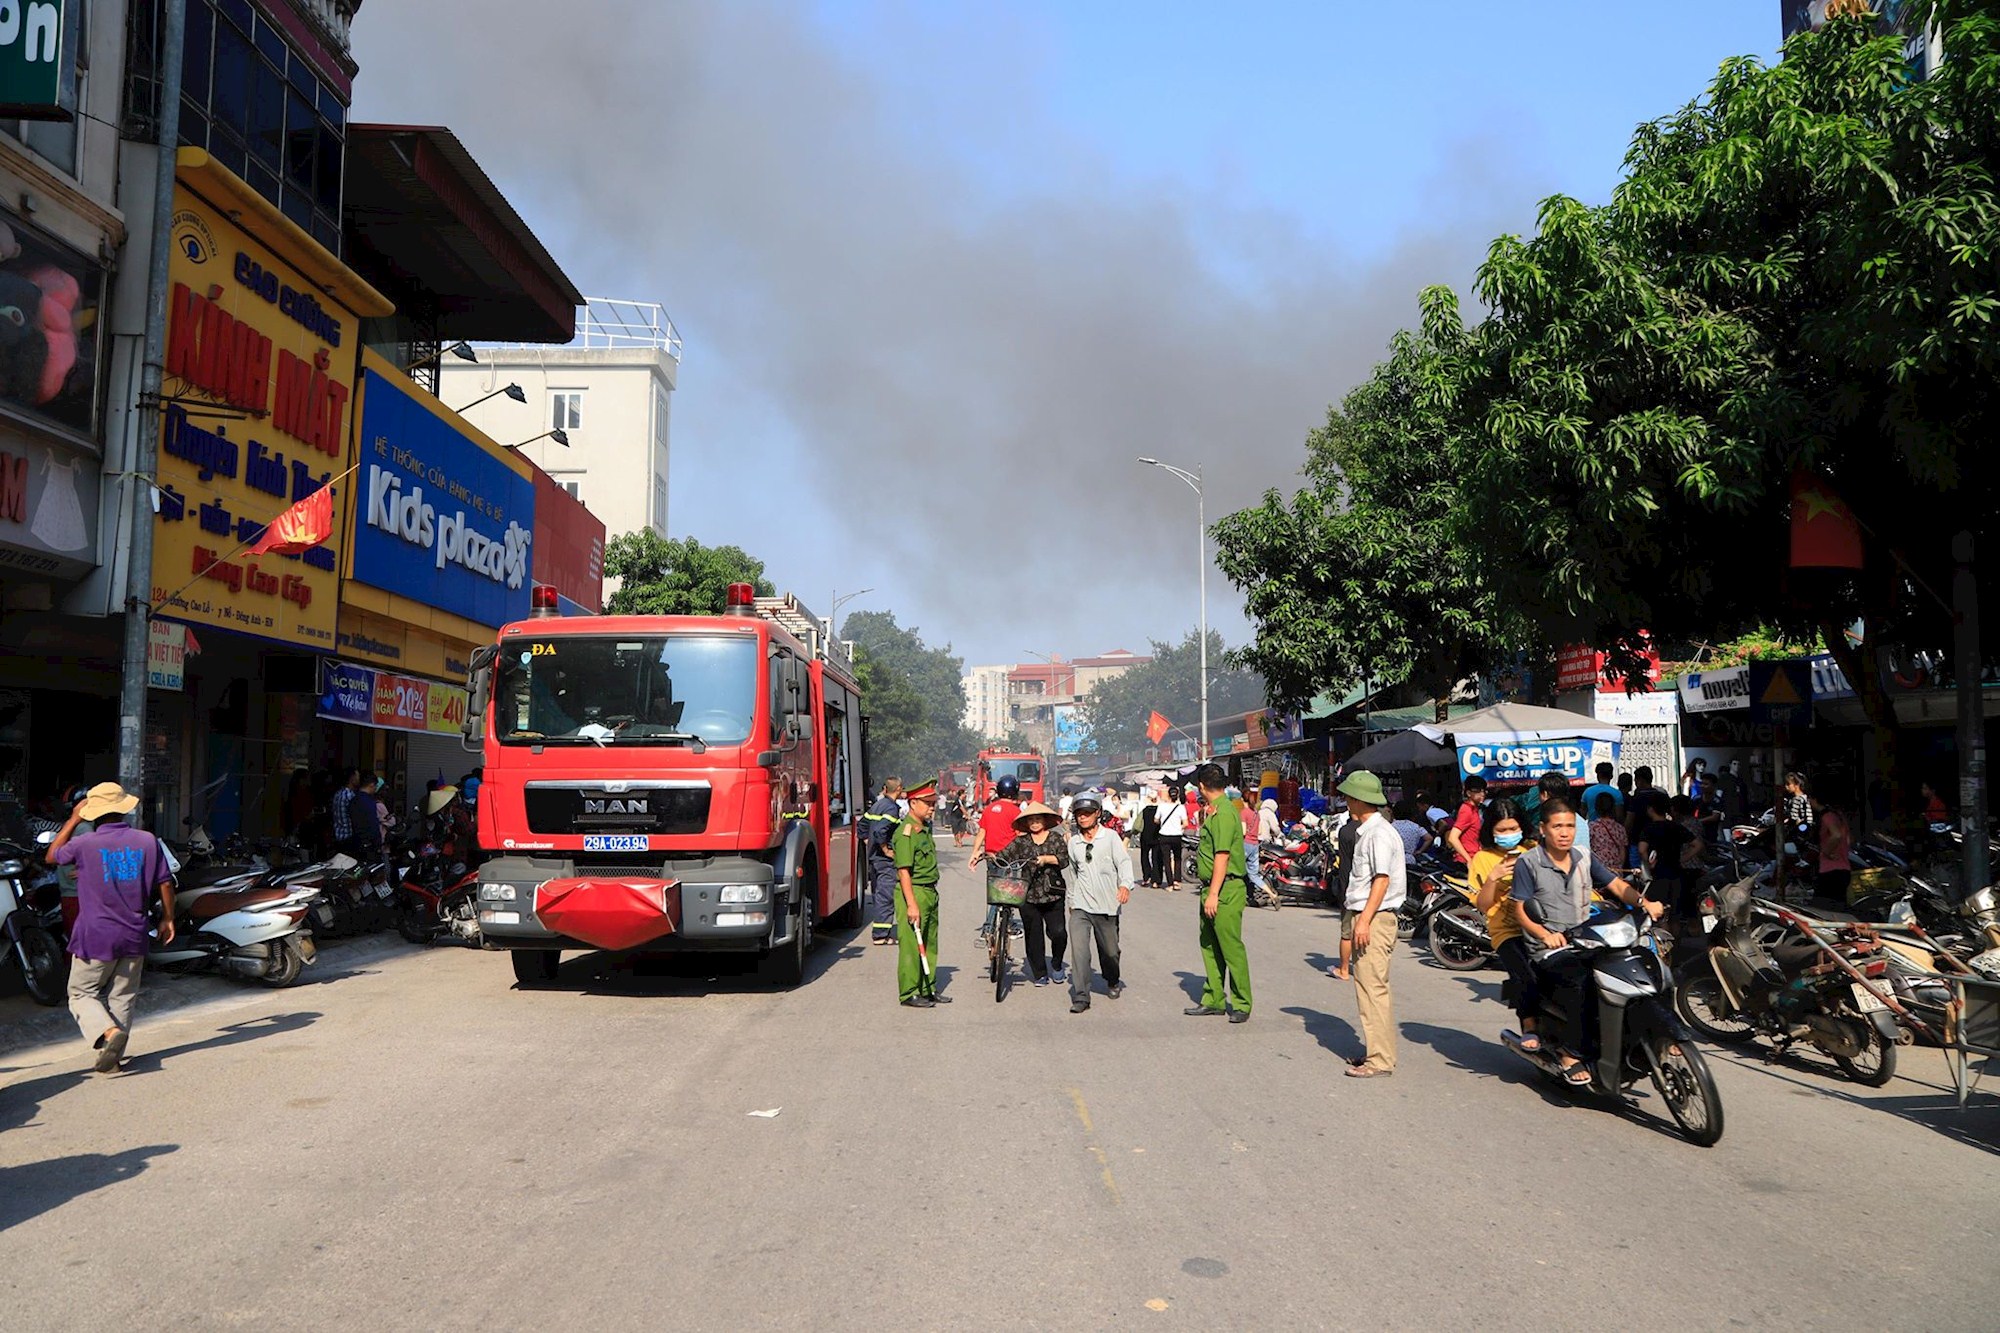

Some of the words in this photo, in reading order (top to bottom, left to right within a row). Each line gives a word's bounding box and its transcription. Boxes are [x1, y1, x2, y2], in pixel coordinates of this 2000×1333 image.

[234, 250, 279, 305] CAO
[165, 281, 273, 419] KÍNH
[391, 445, 426, 479] THỐNG
[367, 464, 435, 548] Kids
[435, 510, 506, 582] plaza
[152, 586, 168, 602] 124
[190, 599, 202, 610] Cao
[246, 563, 280, 596] Cao
[281, 573, 313, 610] Cấp
[531, 643, 557, 657] ĐA
[1496, 769, 1528, 779] OCEAN
[585, 799, 648, 814] MAN
[585, 836, 648, 850] 29A-023.94
